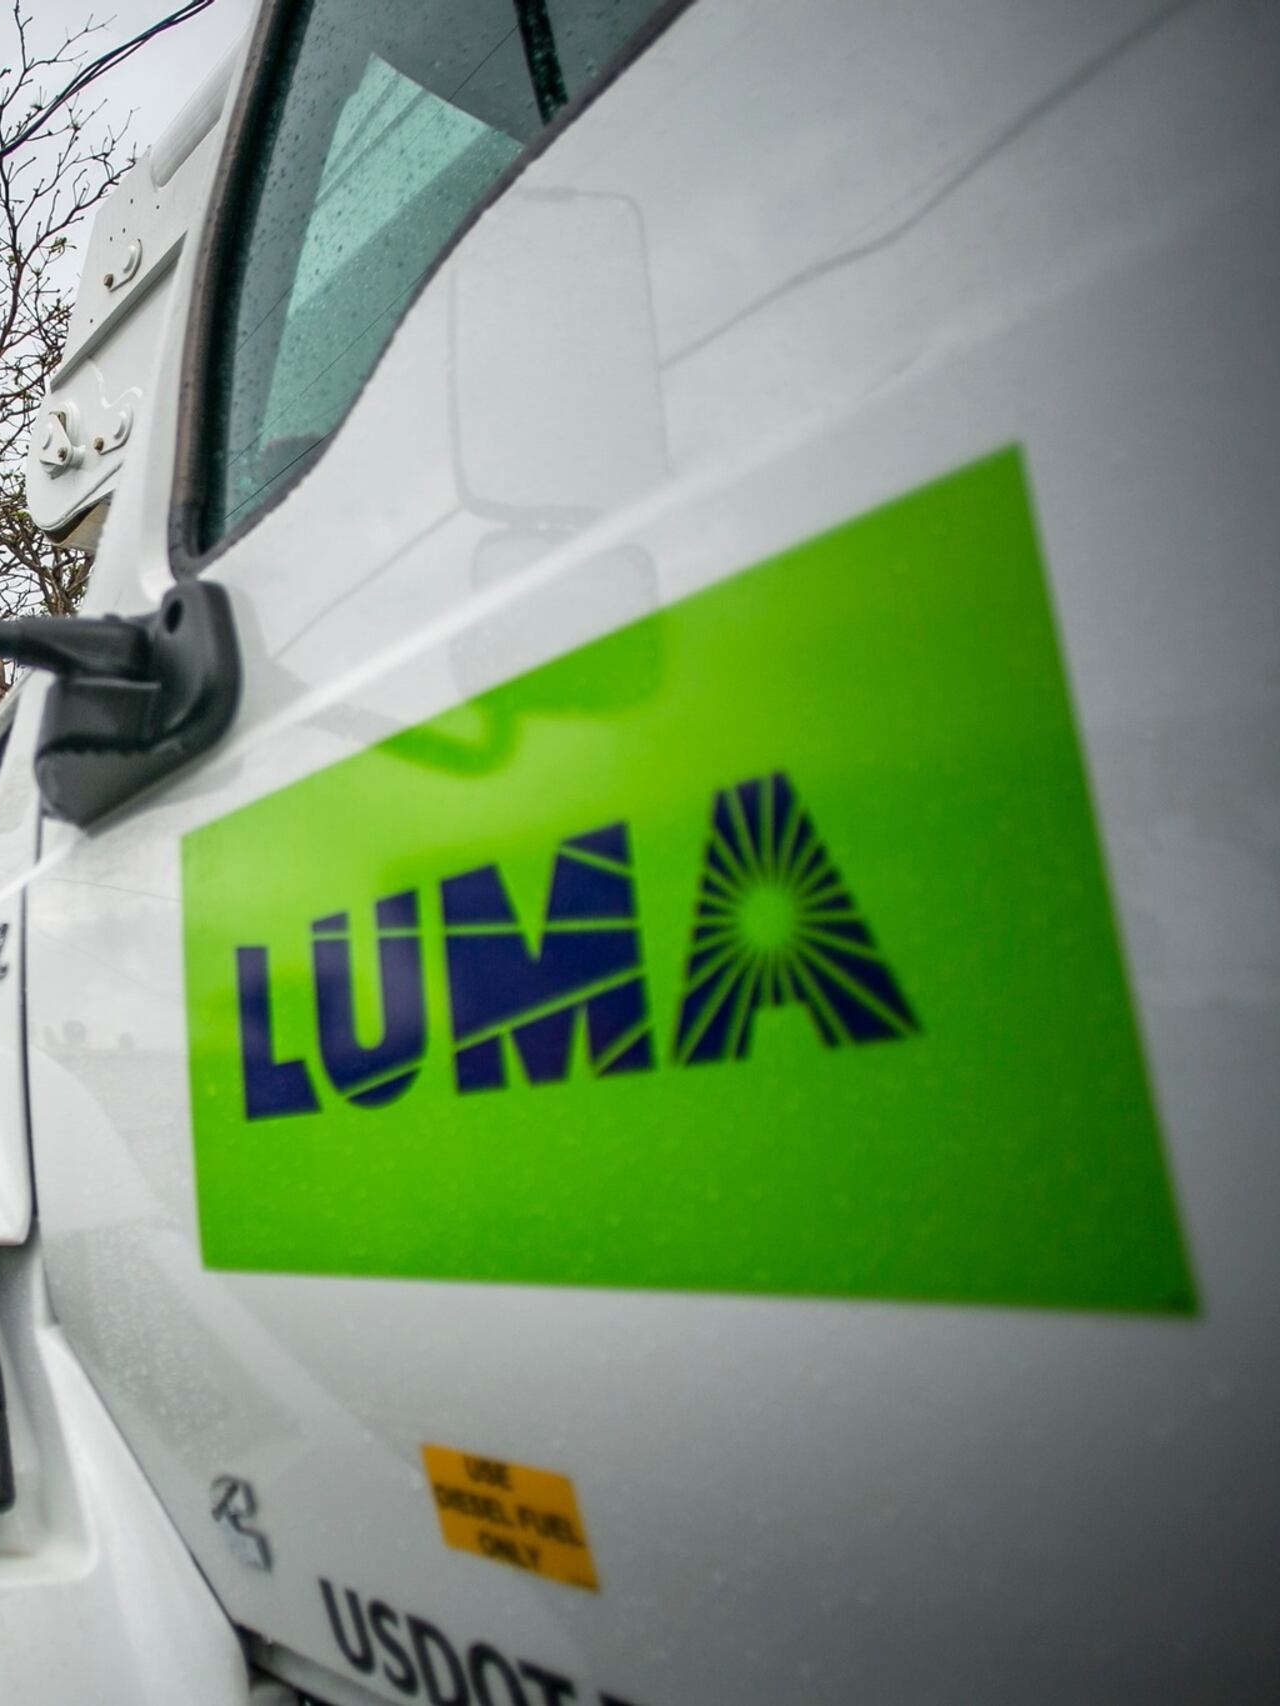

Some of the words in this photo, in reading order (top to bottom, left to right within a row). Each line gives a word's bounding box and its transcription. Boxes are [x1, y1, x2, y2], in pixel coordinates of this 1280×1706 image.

[236, 770, 926, 1123] LUMA
[463, 1455, 513, 1491] USE
[432, 1482, 515, 1527] DIESEL
[516, 1503, 586, 1548] FUEL
[476, 1530, 540, 1571] ONLY
